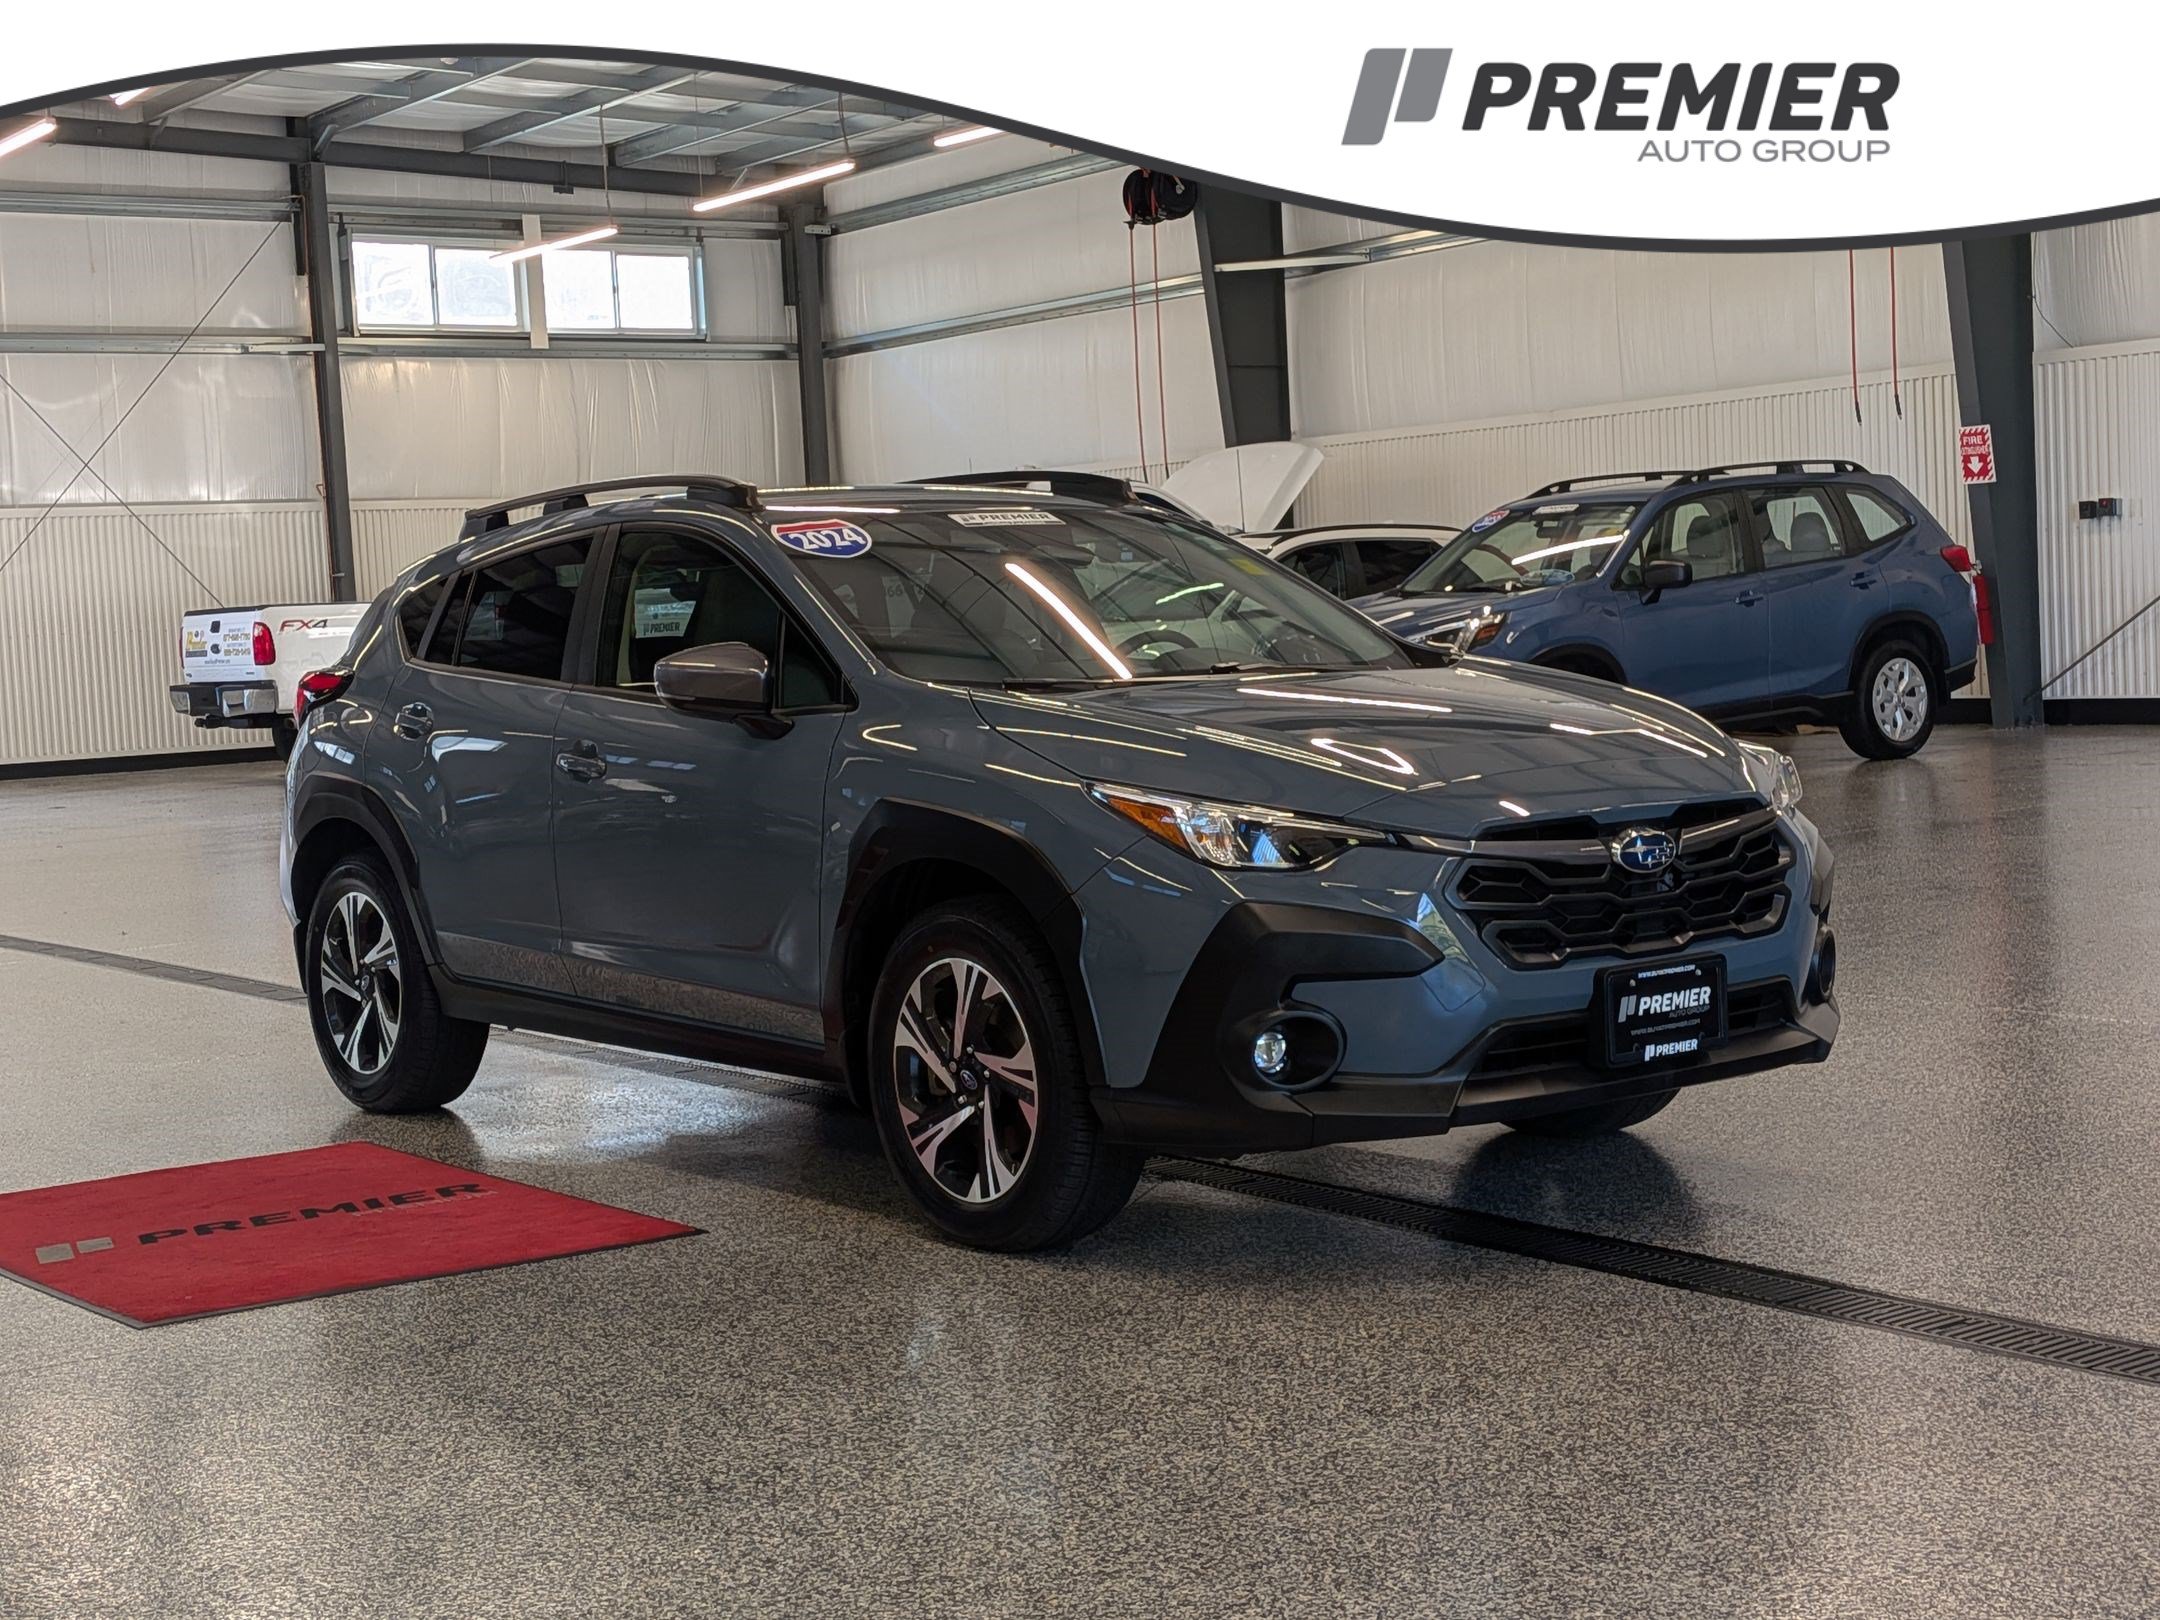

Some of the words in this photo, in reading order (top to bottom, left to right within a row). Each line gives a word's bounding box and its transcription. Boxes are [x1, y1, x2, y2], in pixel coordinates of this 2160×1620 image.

[1962, 435, 1983, 446] FIRE
[978, 512, 1053, 521] PREMIER
[788, 526, 866, 551] 2024
[280, 618, 329, 633] FX4
[650, 621, 681, 634] PREMIER
[1638, 985, 1712, 1017] PREMIER
[1656, 1038, 1699, 1057] PREMIER
[138, 1183, 484, 1245] PREMIER
